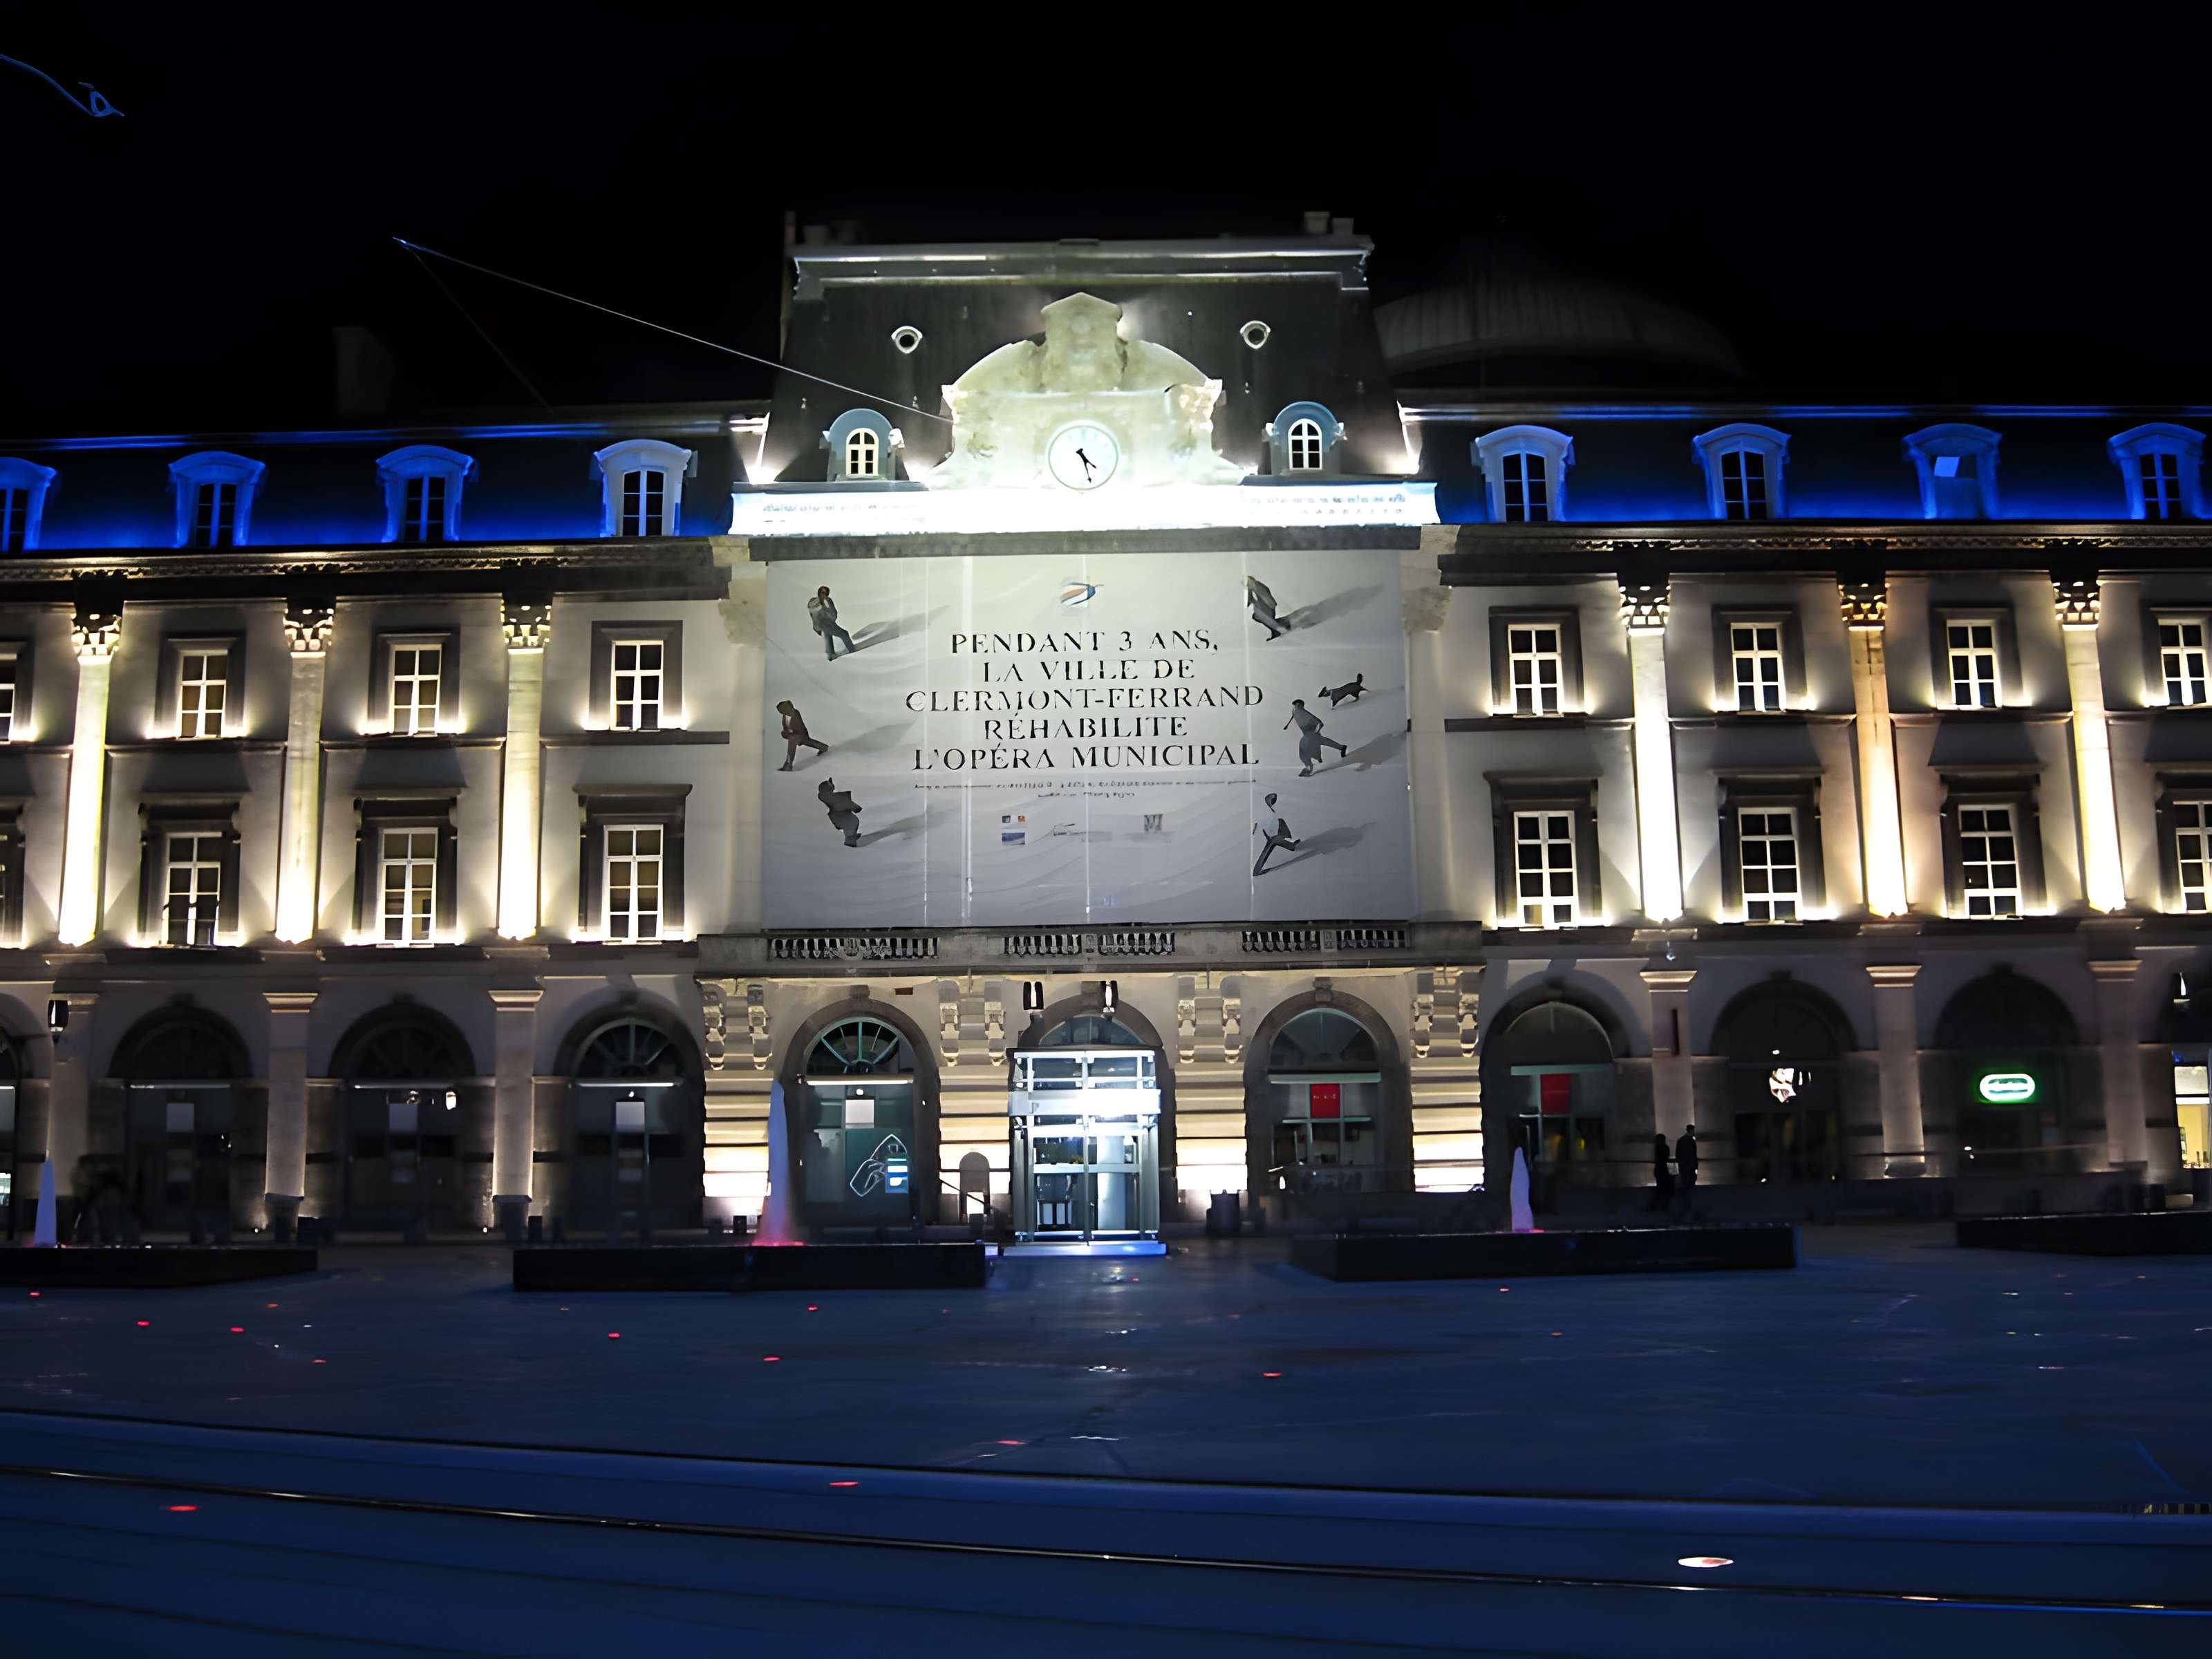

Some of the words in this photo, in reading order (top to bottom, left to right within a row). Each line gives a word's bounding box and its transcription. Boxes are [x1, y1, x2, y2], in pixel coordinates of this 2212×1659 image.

[951, 630, 1105, 654] PENDANT
[1119, 631, 1132, 651] 3
[1150, 629, 1219, 655] ANS,
[984, 662, 1024, 682] LA
[1040, 659, 1139, 682] VILLE
[1154, 659, 1195, 679] DE
[906, 686, 1264, 712] CLERMONT-FERRAND
[984, 713, 1188, 740] RÉHABILITE
[912, 742, 1056, 770] L'OPÉRA
[1071, 743, 1259, 768] MUNICIPAL
